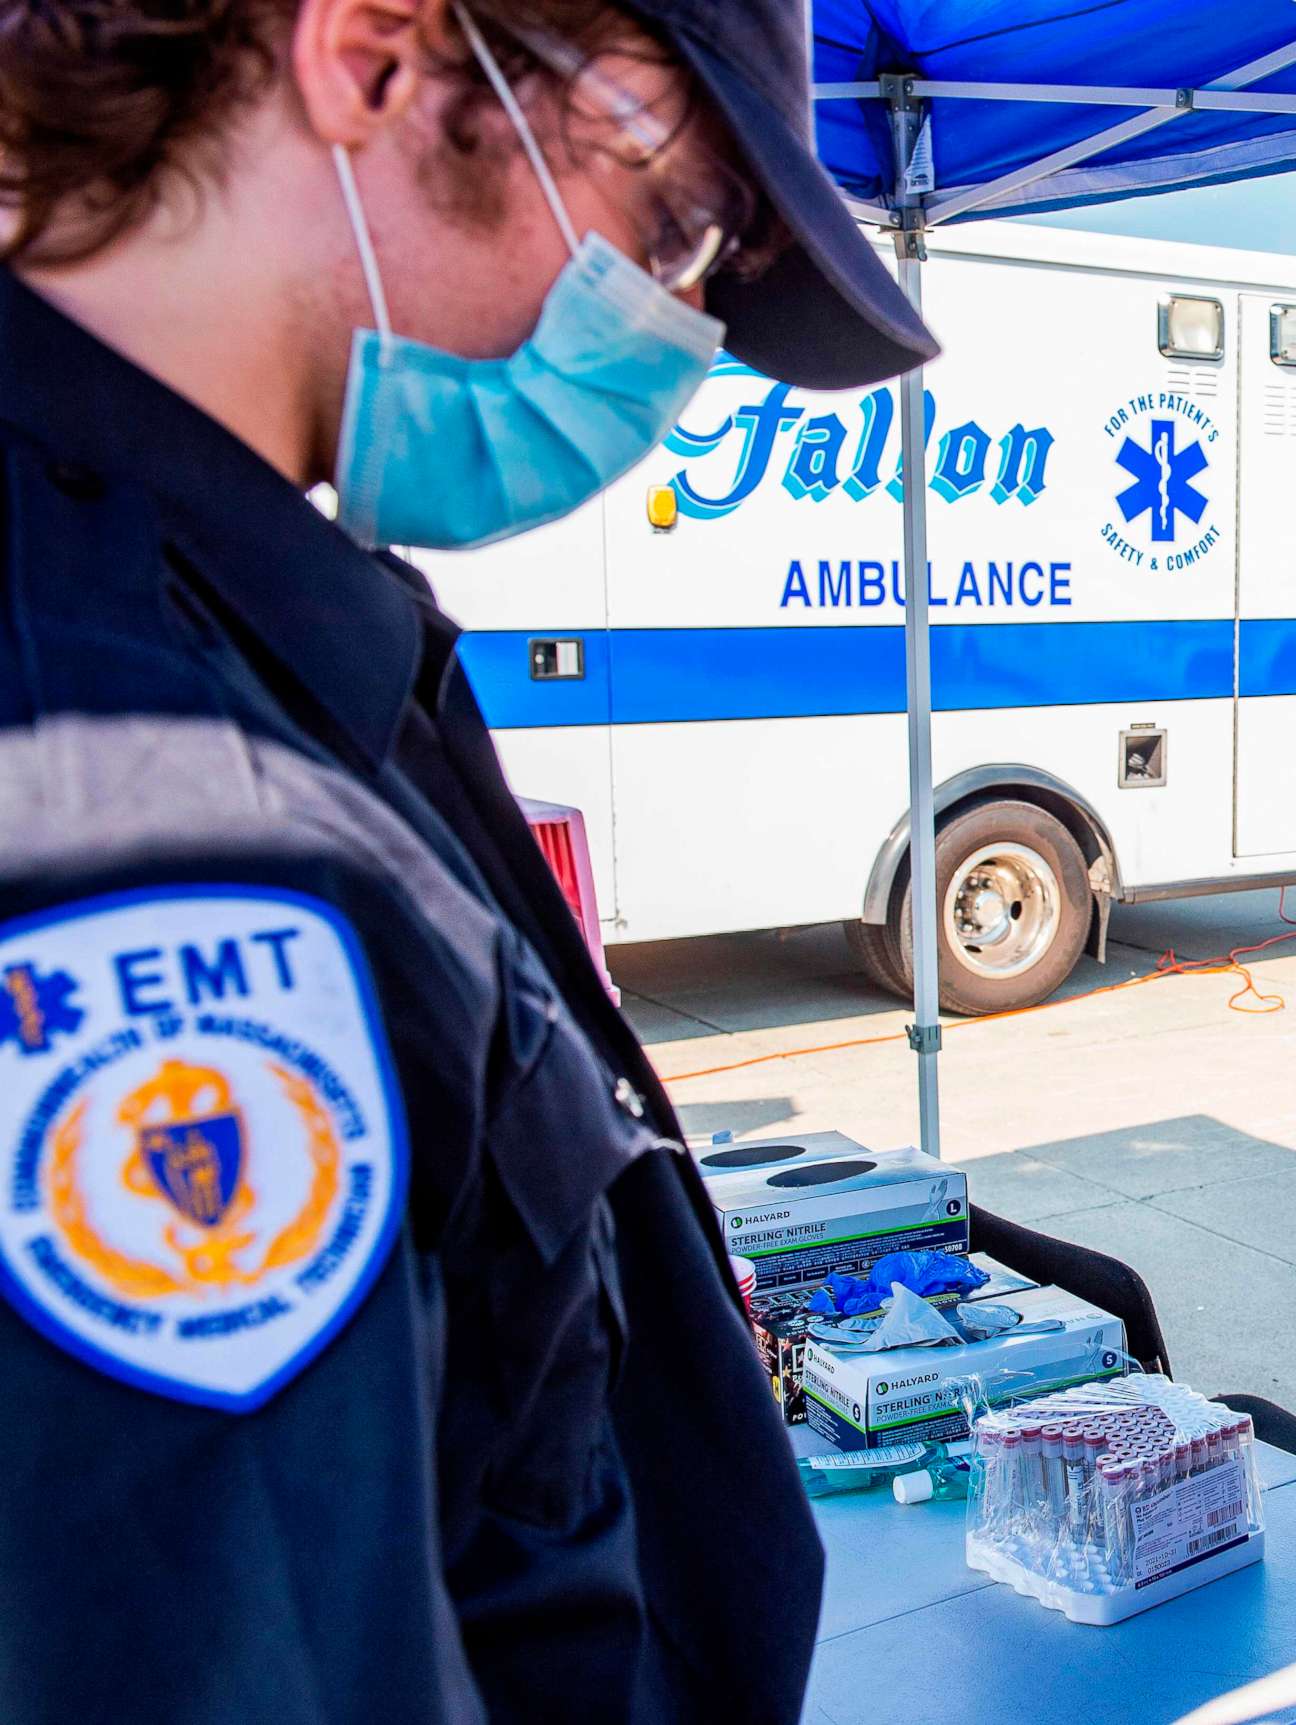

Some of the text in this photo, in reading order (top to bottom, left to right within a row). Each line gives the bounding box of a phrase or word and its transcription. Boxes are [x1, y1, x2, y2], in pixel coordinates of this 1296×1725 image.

[1104, 393, 1219, 442] FOR THE PATIENT'S
[1100, 523, 1221, 571] SAFETY & COMFORT
[114, 927, 299, 1015] EMT
[745, 1211, 790, 1225] HALYARD
[950, 1203, 957, 1213] L
[731, 1223, 826, 1247] STERLING NITRILE
[731, 1240, 779, 1253] POWDER-FREE
[799, 1233, 824, 1242] GLOVES
[814, 1354, 834, 1374] HALYARD
[1106, 1354, 1113, 1365] S
[806, 1370, 829, 1392] STERLING
[891, 1373, 939, 1390] HALYARD
[876, 1395, 930, 1414] STERLING
